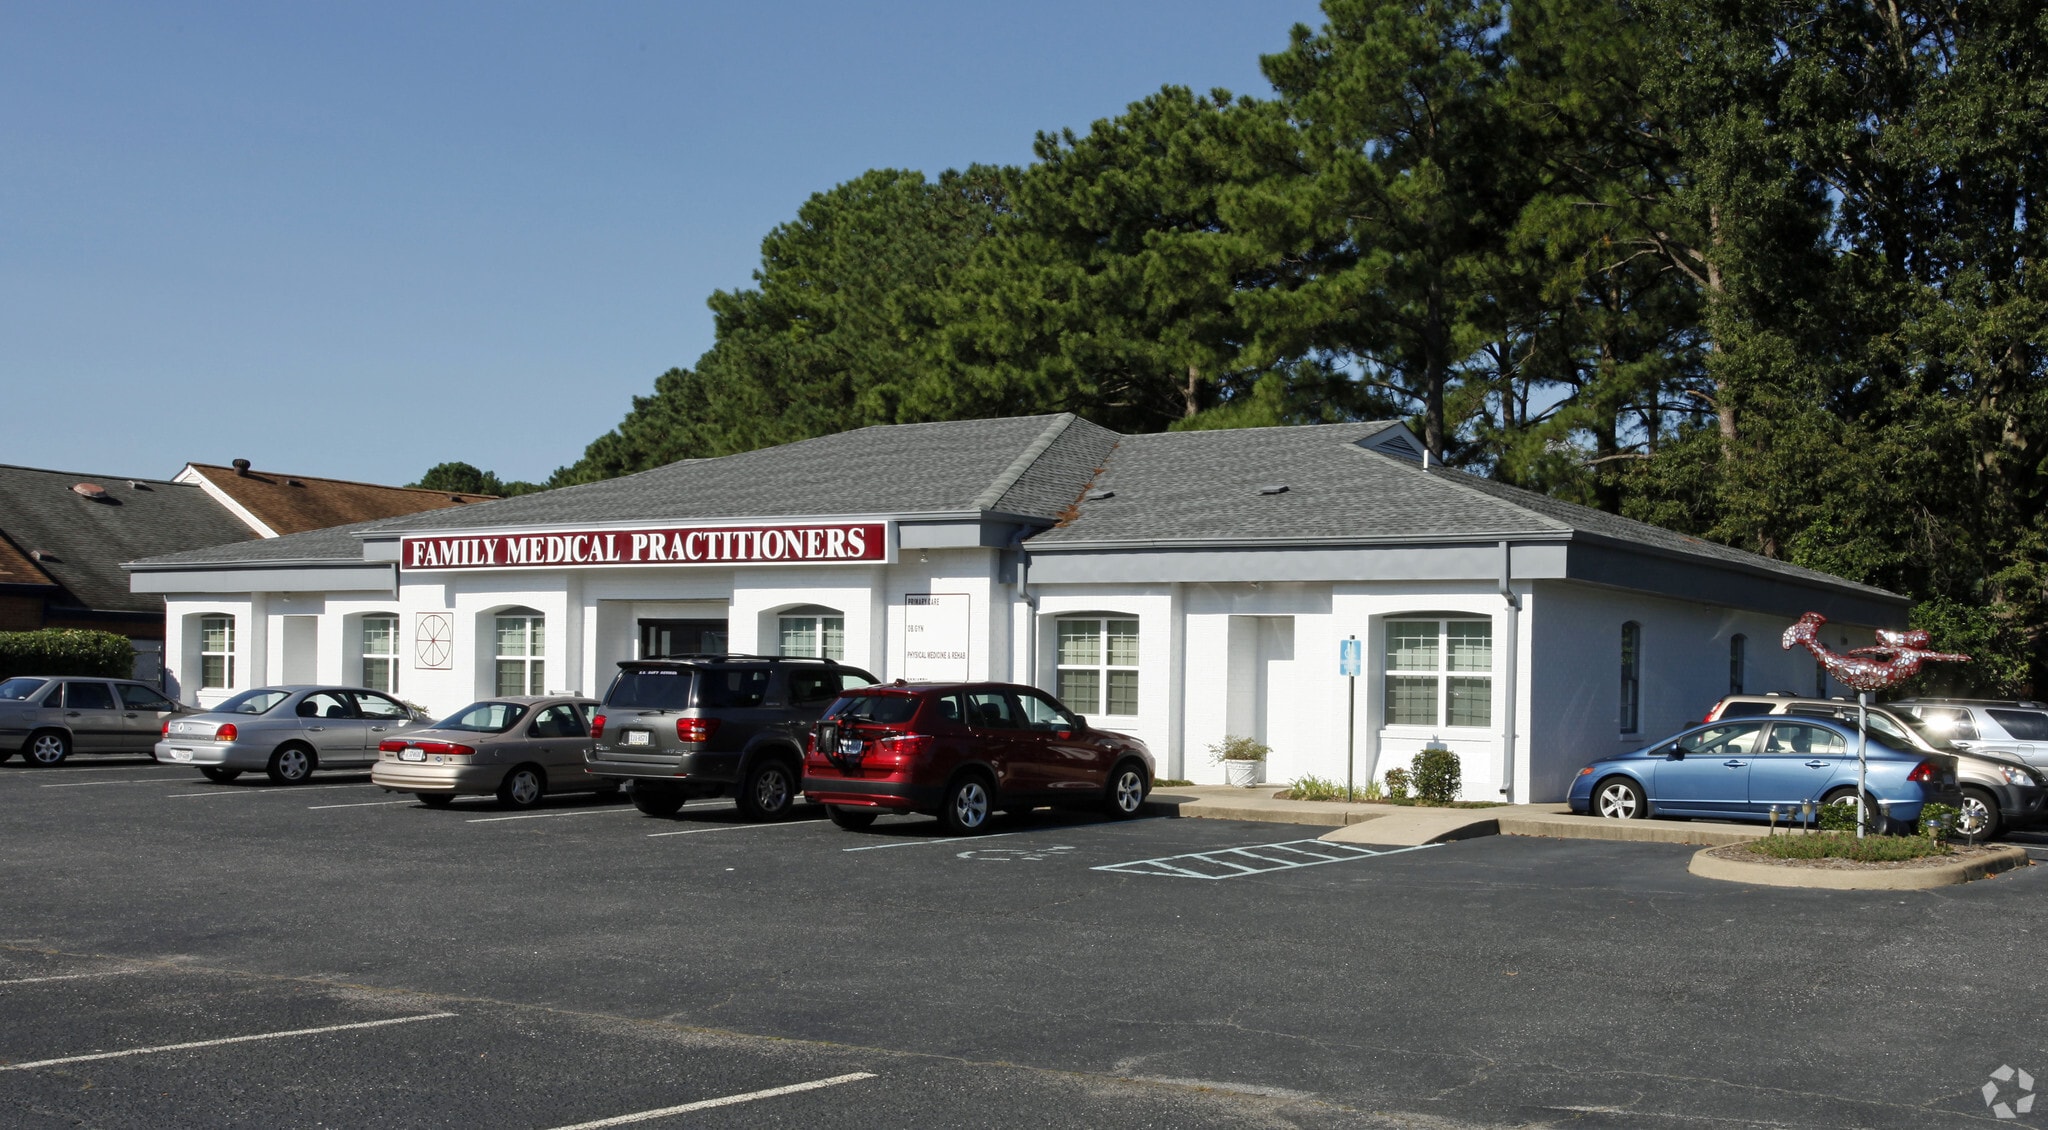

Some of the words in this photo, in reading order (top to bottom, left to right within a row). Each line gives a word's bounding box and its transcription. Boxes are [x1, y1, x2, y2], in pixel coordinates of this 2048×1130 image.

[411, 538, 499, 567] FAMILY
[505, 534, 621, 564] MEDICAL
[630, 527, 866, 561] PRACTITIONERS
[907, 598, 927, 606] PRIMARY
[928, 598, 940, 606] CARE
[907, 651, 926, 659] PHYSICAL
[927, 651, 947, 659] MEDICINE
[951, 651, 966, 660] REHAB
